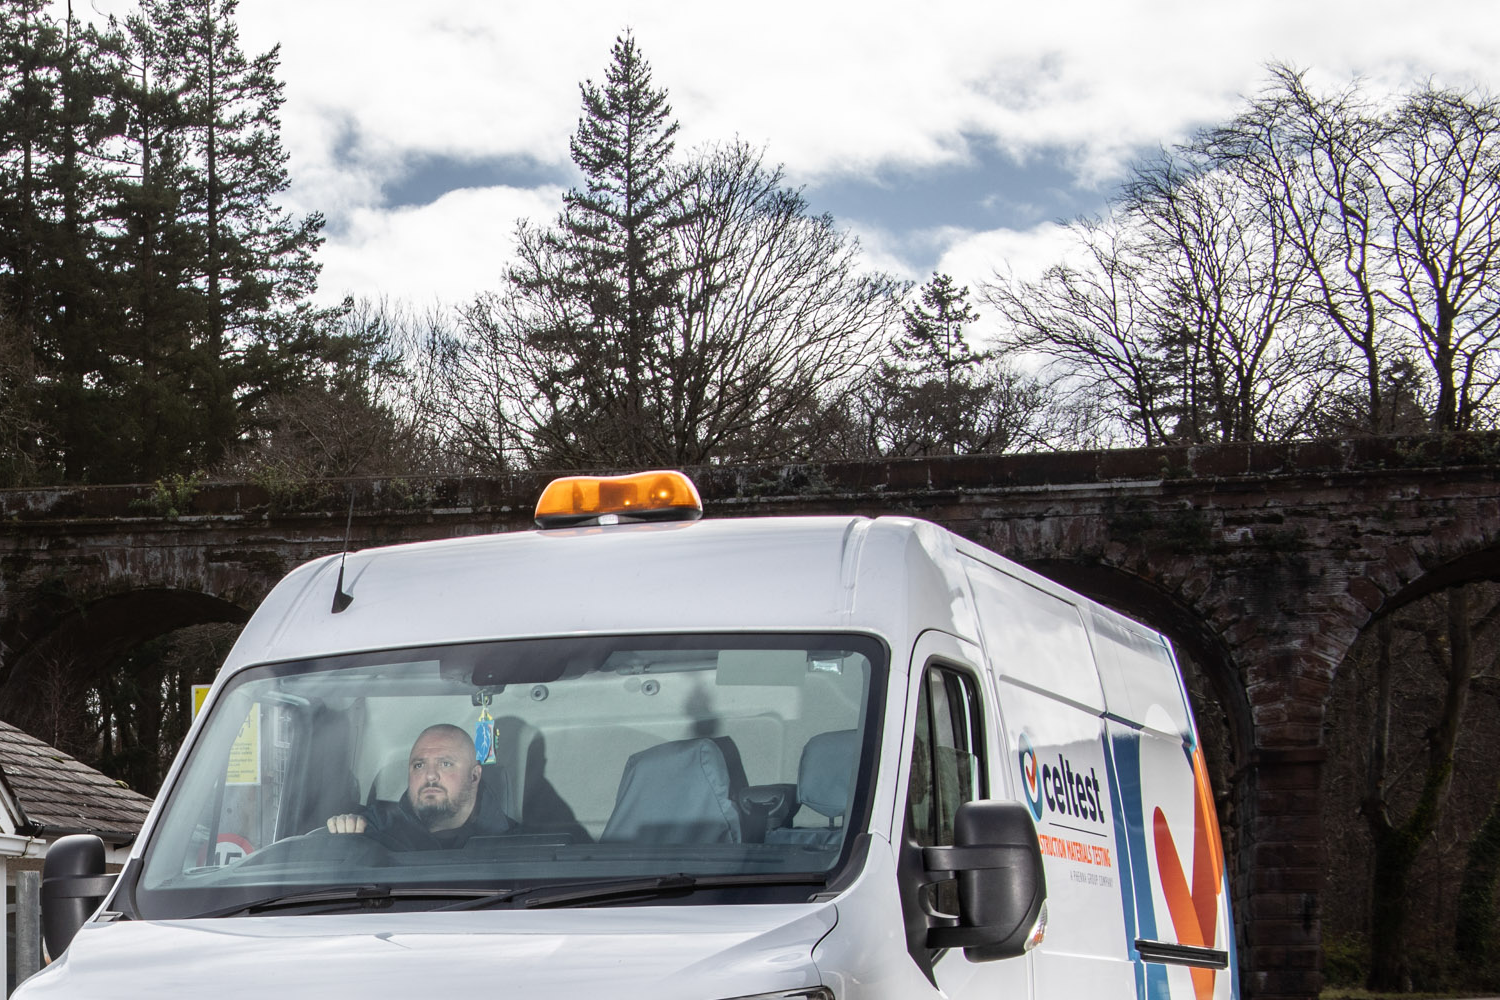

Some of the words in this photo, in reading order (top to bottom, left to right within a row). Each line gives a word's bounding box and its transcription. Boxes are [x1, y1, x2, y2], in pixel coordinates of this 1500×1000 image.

[1042, 753, 1105, 824] celtest
[1066, 840, 1092, 864] MATERIALS
[1092, 845, 1111, 868] TESTING
